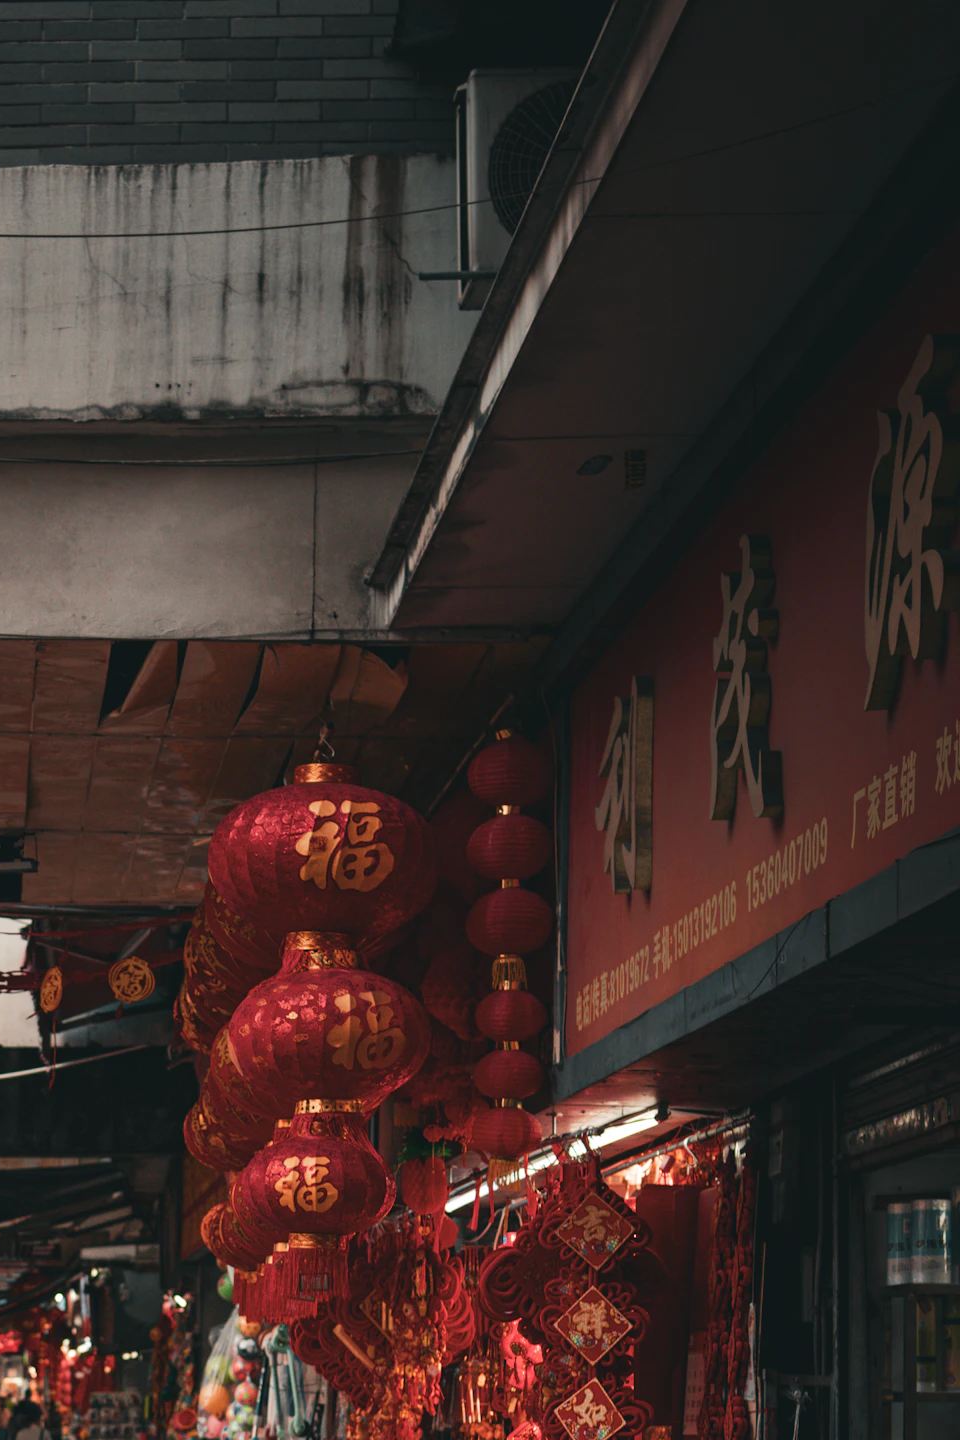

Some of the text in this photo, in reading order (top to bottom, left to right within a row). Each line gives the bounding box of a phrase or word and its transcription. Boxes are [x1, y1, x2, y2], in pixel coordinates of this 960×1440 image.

[295, 799, 395, 893] 福
[746, 817, 828, 912] 15360407009
[851, 750, 917, 850] 厂家直销
[326, 990, 407, 1072] 福
[275, 1156, 339, 1213] 福
